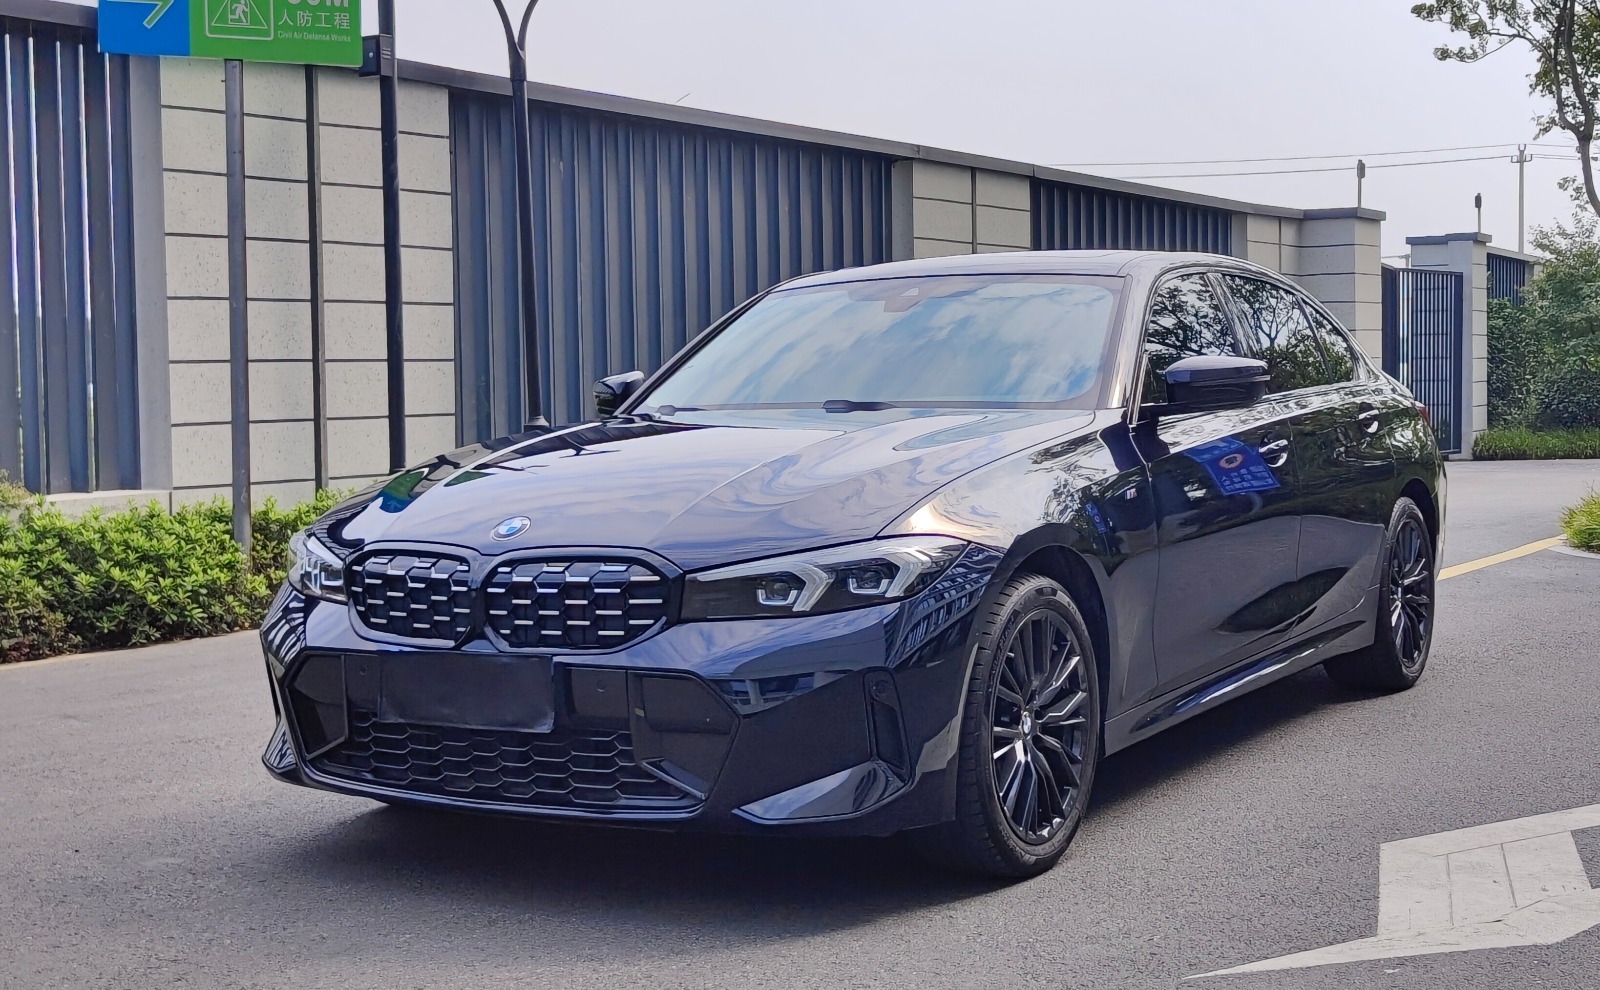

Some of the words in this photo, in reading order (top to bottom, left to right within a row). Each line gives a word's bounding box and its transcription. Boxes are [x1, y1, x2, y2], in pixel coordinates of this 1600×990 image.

[278, 9, 351, 29] 人防工程
[278, 31, 292, 39] Civil
[293, 31, 302, 39] Air
[331, 33, 351, 42] Works
